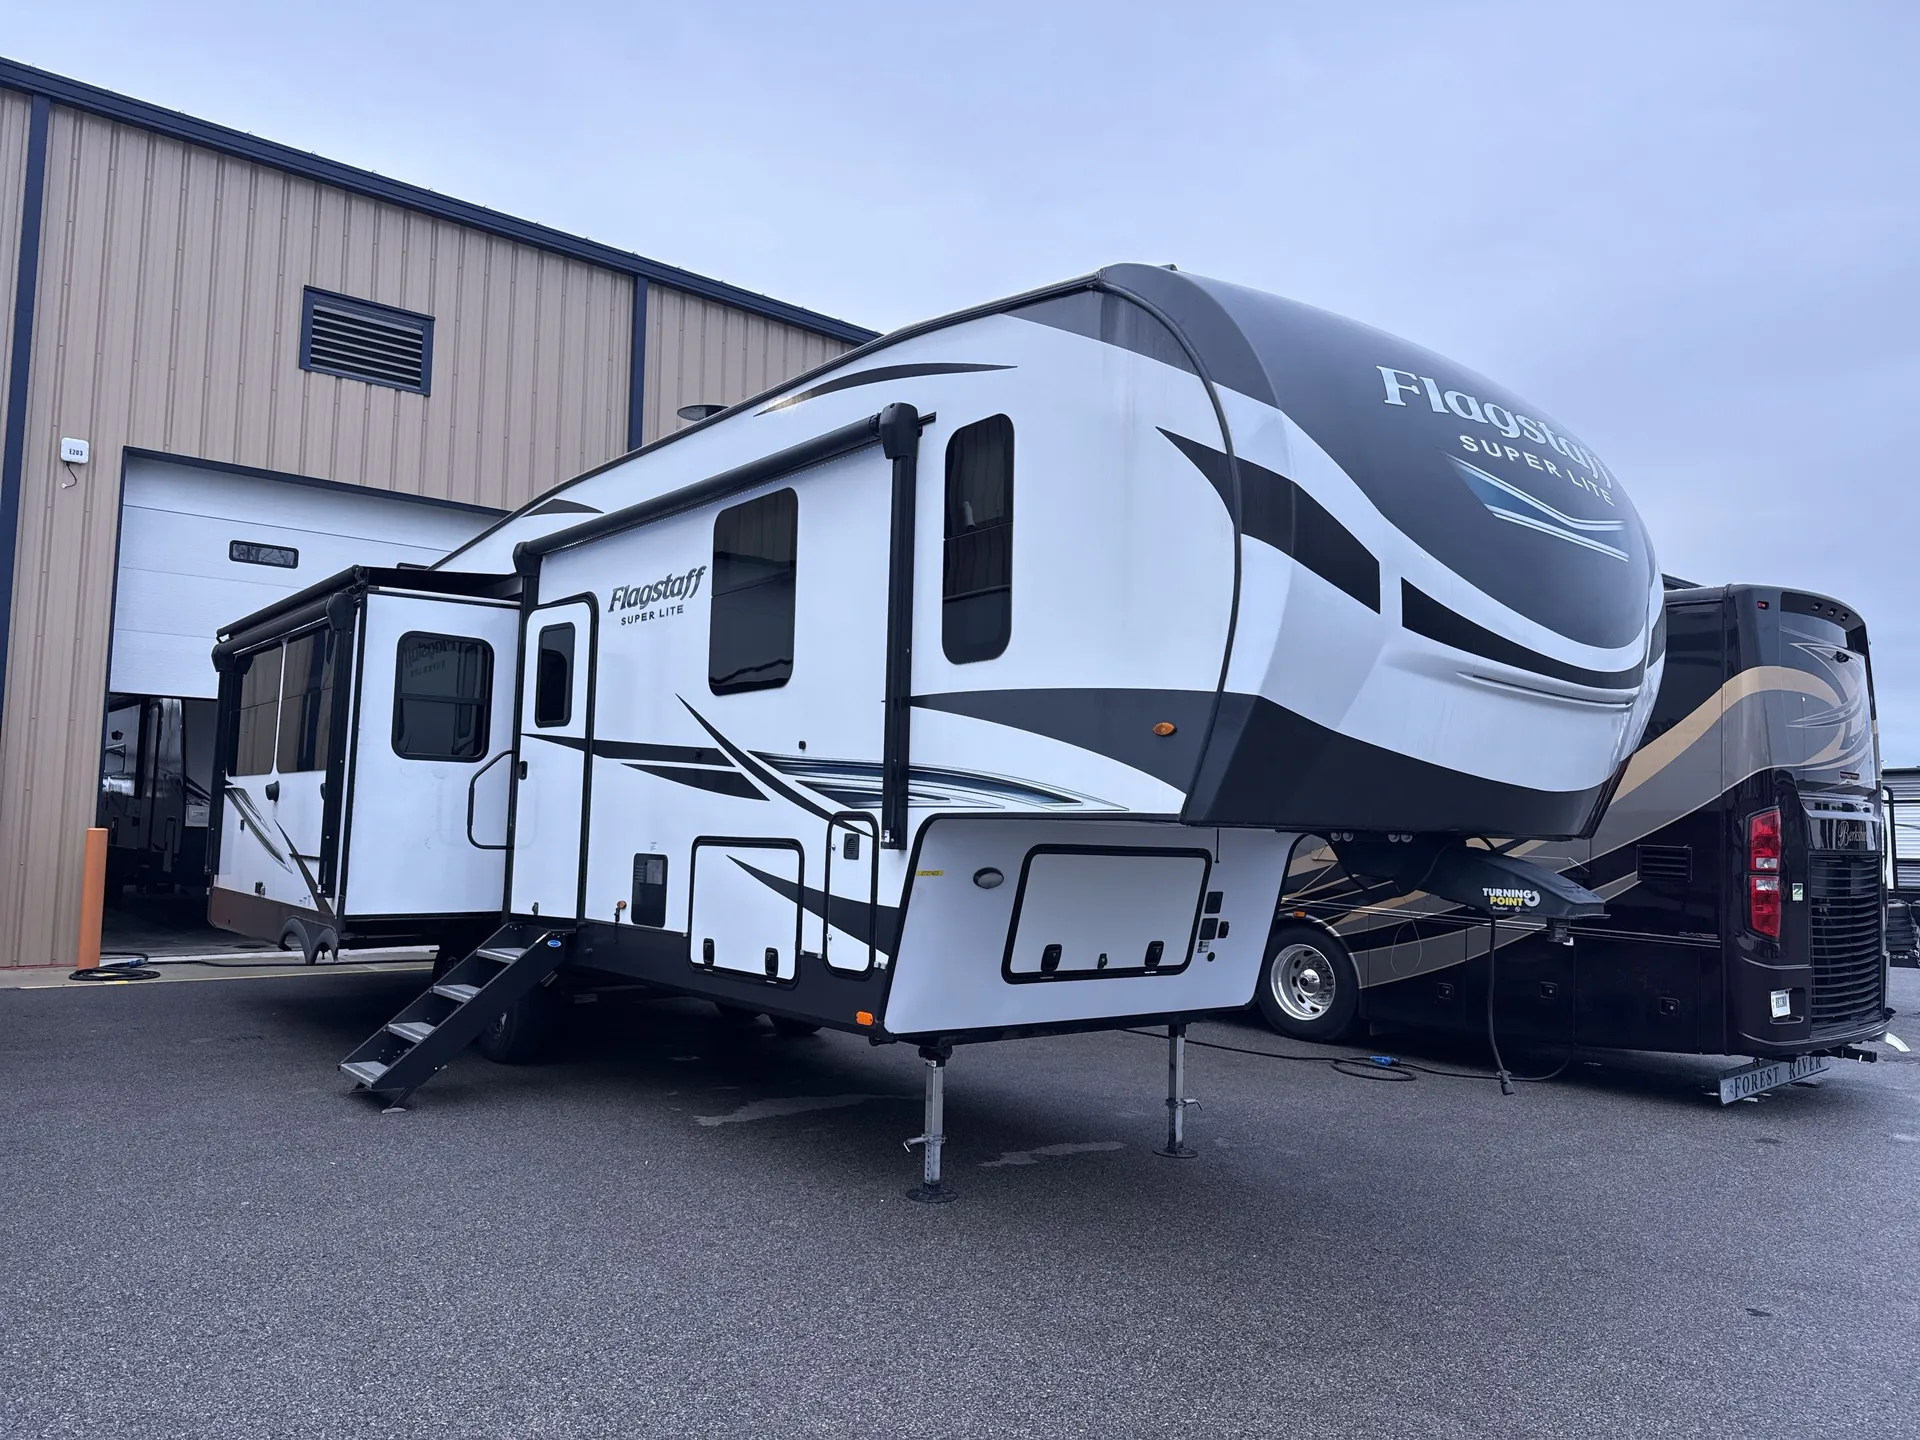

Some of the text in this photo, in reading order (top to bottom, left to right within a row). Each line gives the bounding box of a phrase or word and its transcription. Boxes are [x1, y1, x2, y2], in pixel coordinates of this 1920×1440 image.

[1375, 365, 1612, 490] Flagstaff
[69, 448, 83, 457] E203
[1459, 434, 1615, 507] SUPER LITE
[607, 565, 707, 613] Flagstaff
[620, 604, 684, 626] SUPER LITE
[1482, 887, 1532, 899] TURNING
[1490, 896, 1523, 907] POINT
[1734, 1055, 1822, 1099] FOREST RIVER
